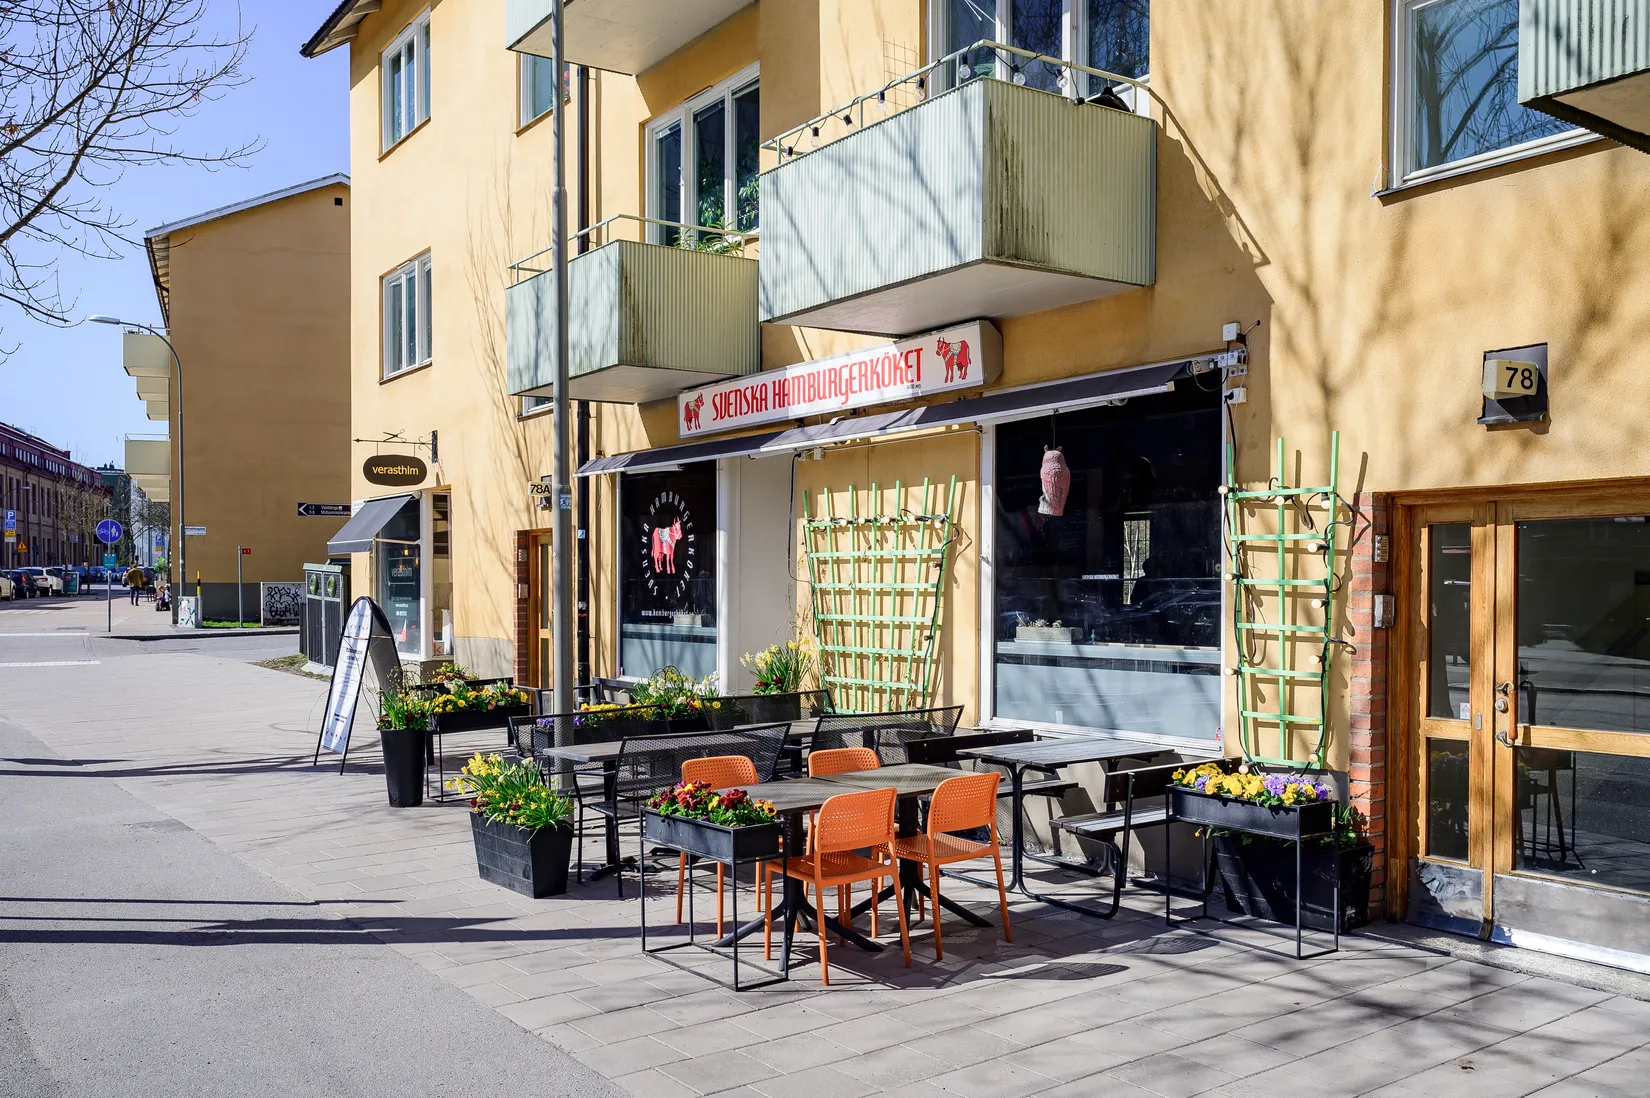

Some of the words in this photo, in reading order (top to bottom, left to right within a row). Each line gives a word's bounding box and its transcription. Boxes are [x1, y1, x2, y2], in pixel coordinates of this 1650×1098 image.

[1505, 366, 1534, 390] 78
[712, 383, 769, 421] SVENSKA
[772, 347, 924, 409] HAMBURGERKÖKET
[372, 465, 419, 475] verasthlm
[530, 484, 551, 494] 78A
[8, 511, 14, 520] P
